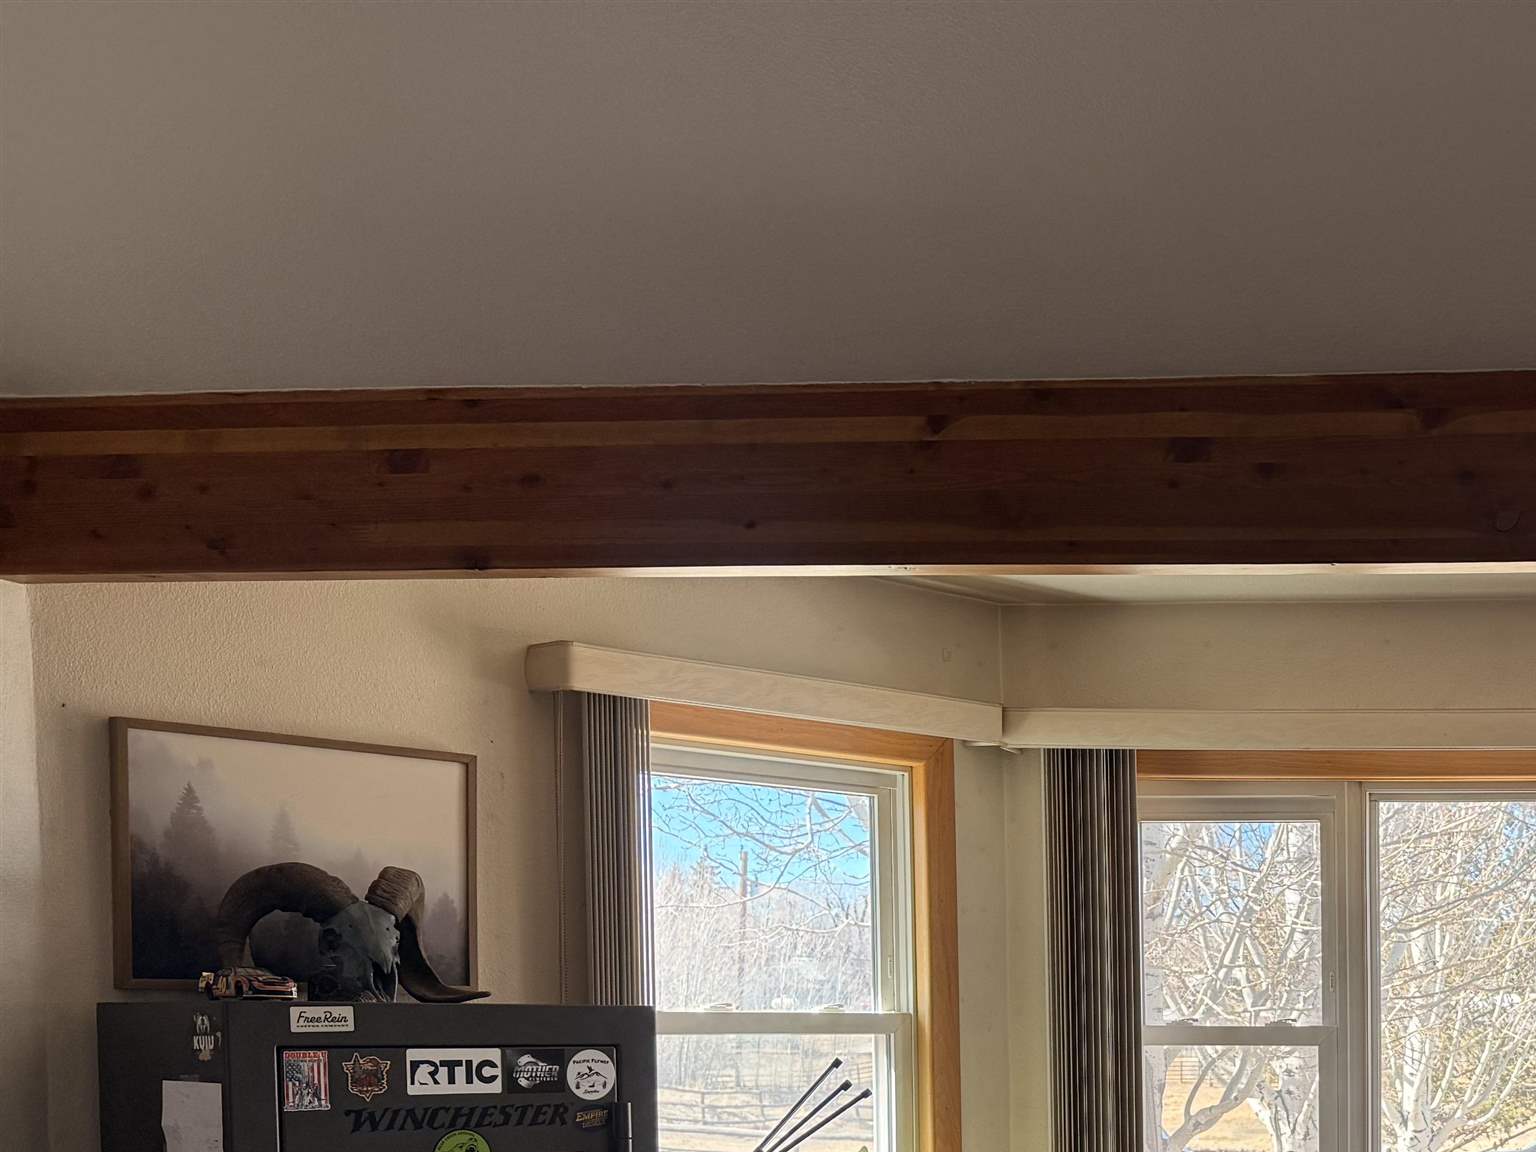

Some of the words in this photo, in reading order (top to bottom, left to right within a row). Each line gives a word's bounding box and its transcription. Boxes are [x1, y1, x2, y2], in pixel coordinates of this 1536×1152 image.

[296, 1010, 322, 1024] Free
[323, 1010, 349, 1023] Rein
[409, 1059, 499, 1086] RTIC
[513, 1065, 560, 1078] MOTHER
[344, 1102, 570, 1135] WINCHESTER
